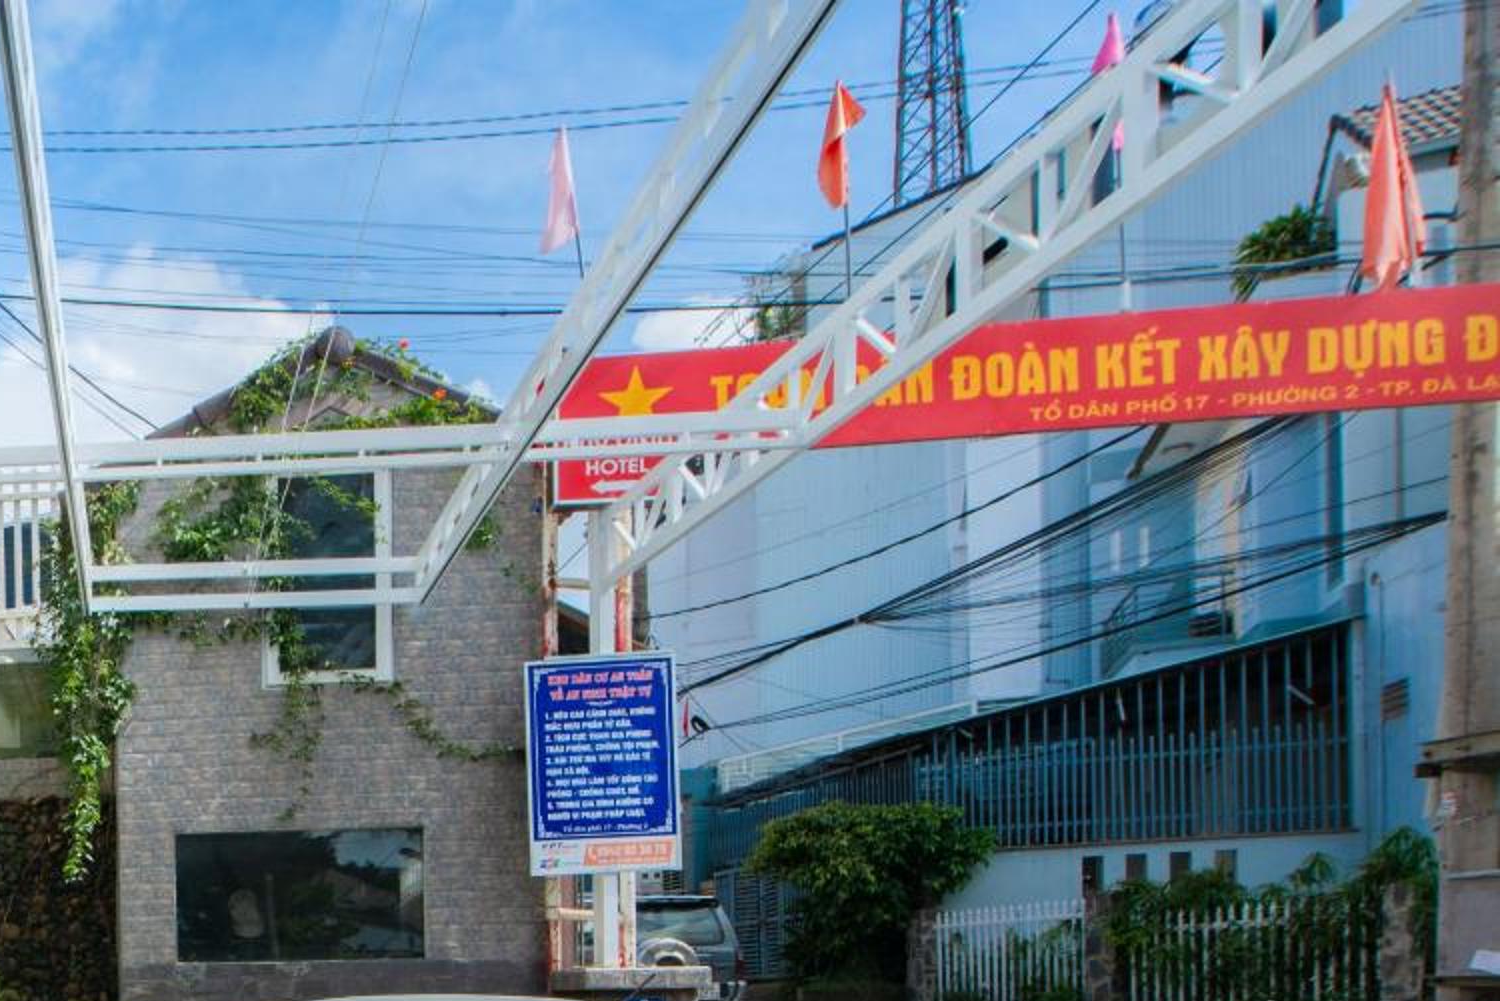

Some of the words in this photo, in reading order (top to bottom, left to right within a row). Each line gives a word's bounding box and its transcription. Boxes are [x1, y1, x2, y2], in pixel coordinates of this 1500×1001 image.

[949, 342, 1080, 401] ĐOÀN
[1095, 327, 1182, 390] KẾT
[1197, 324, 1291, 382] XÂY
[1307, 318, 1446, 378] DỰNG
[1068, 400, 1118, 419] DÂN
[1125, 392, 1177, 415] PHỐ
[1184, 395, 1210, 411] 17
[1345, 384, 1360, 400] 2
[585, 457, 646, 476] HOTEL
